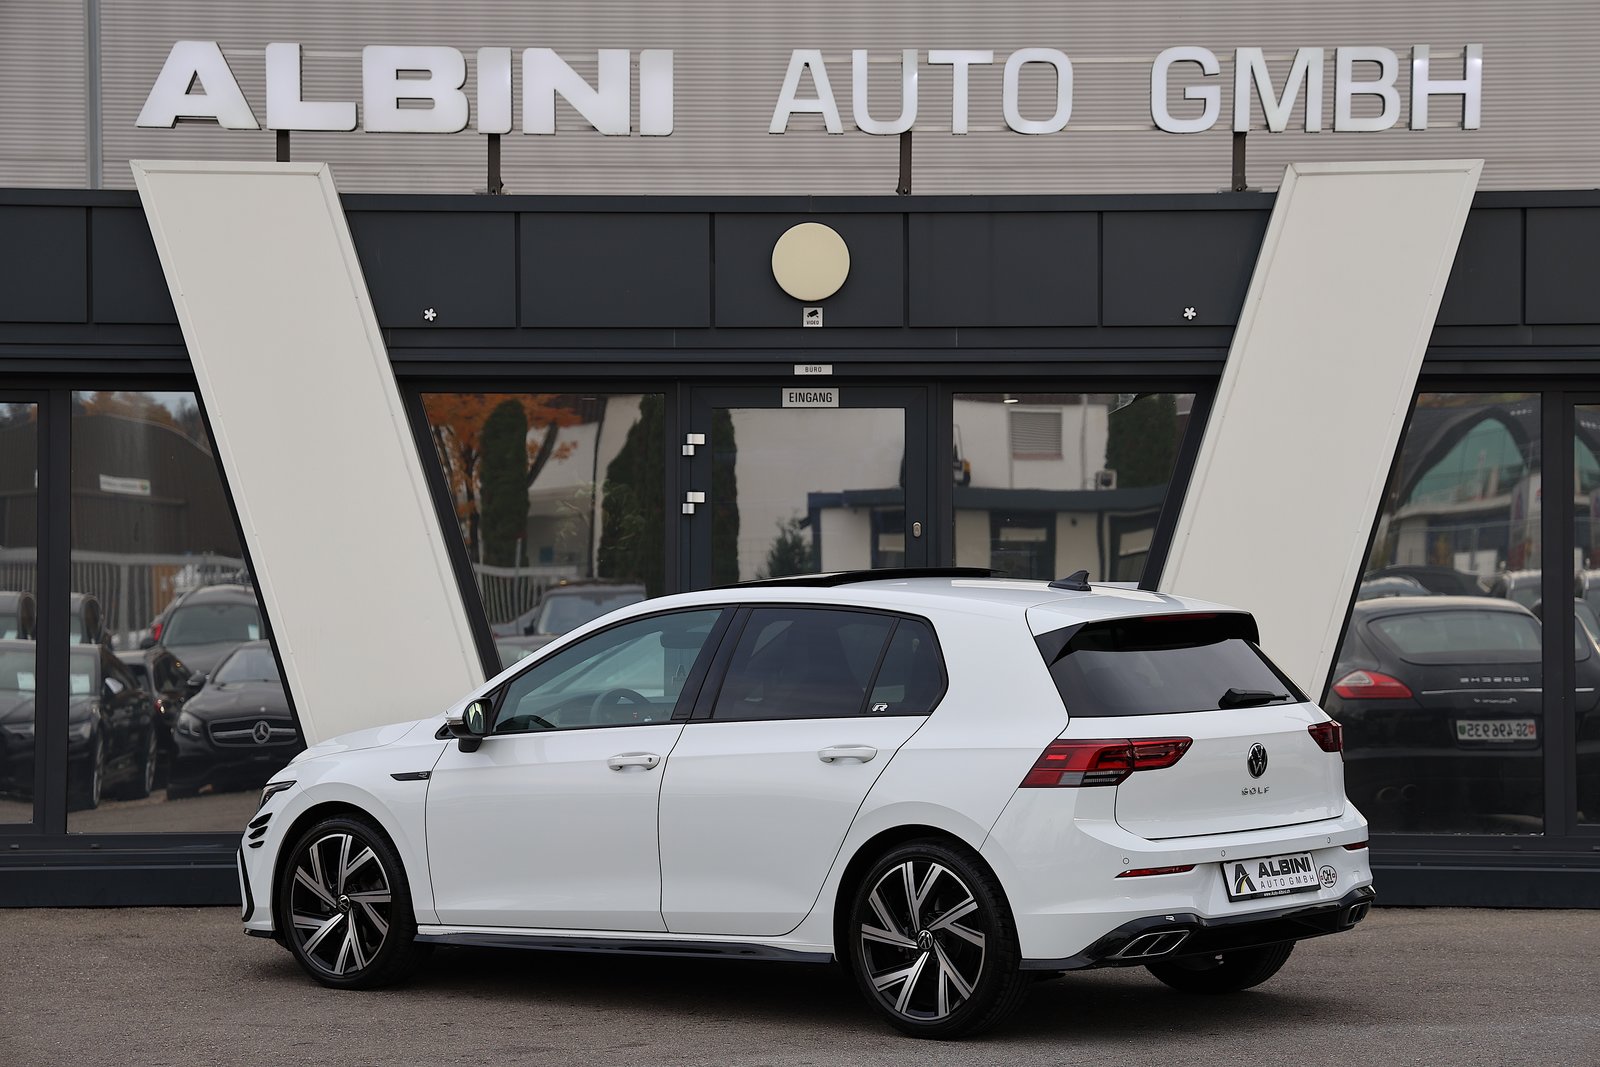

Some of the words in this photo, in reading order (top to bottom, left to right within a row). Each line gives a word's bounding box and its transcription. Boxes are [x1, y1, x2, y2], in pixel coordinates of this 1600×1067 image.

[134, 40, 675, 137] ALBINI
[768, 47, 1074, 136] AUTO
[1149, 43, 1484, 135] GMBH
[788, 392, 833, 403] EINGANG
[1241, 786, 1270, 796] GOLF
[1258, 856, 1312, 878] ALBINI
[1322, 869, 1333, 881] CH
[1260, 878, 1286, 889] AUTO
[1289, 875, 1315, 885] GMBH
